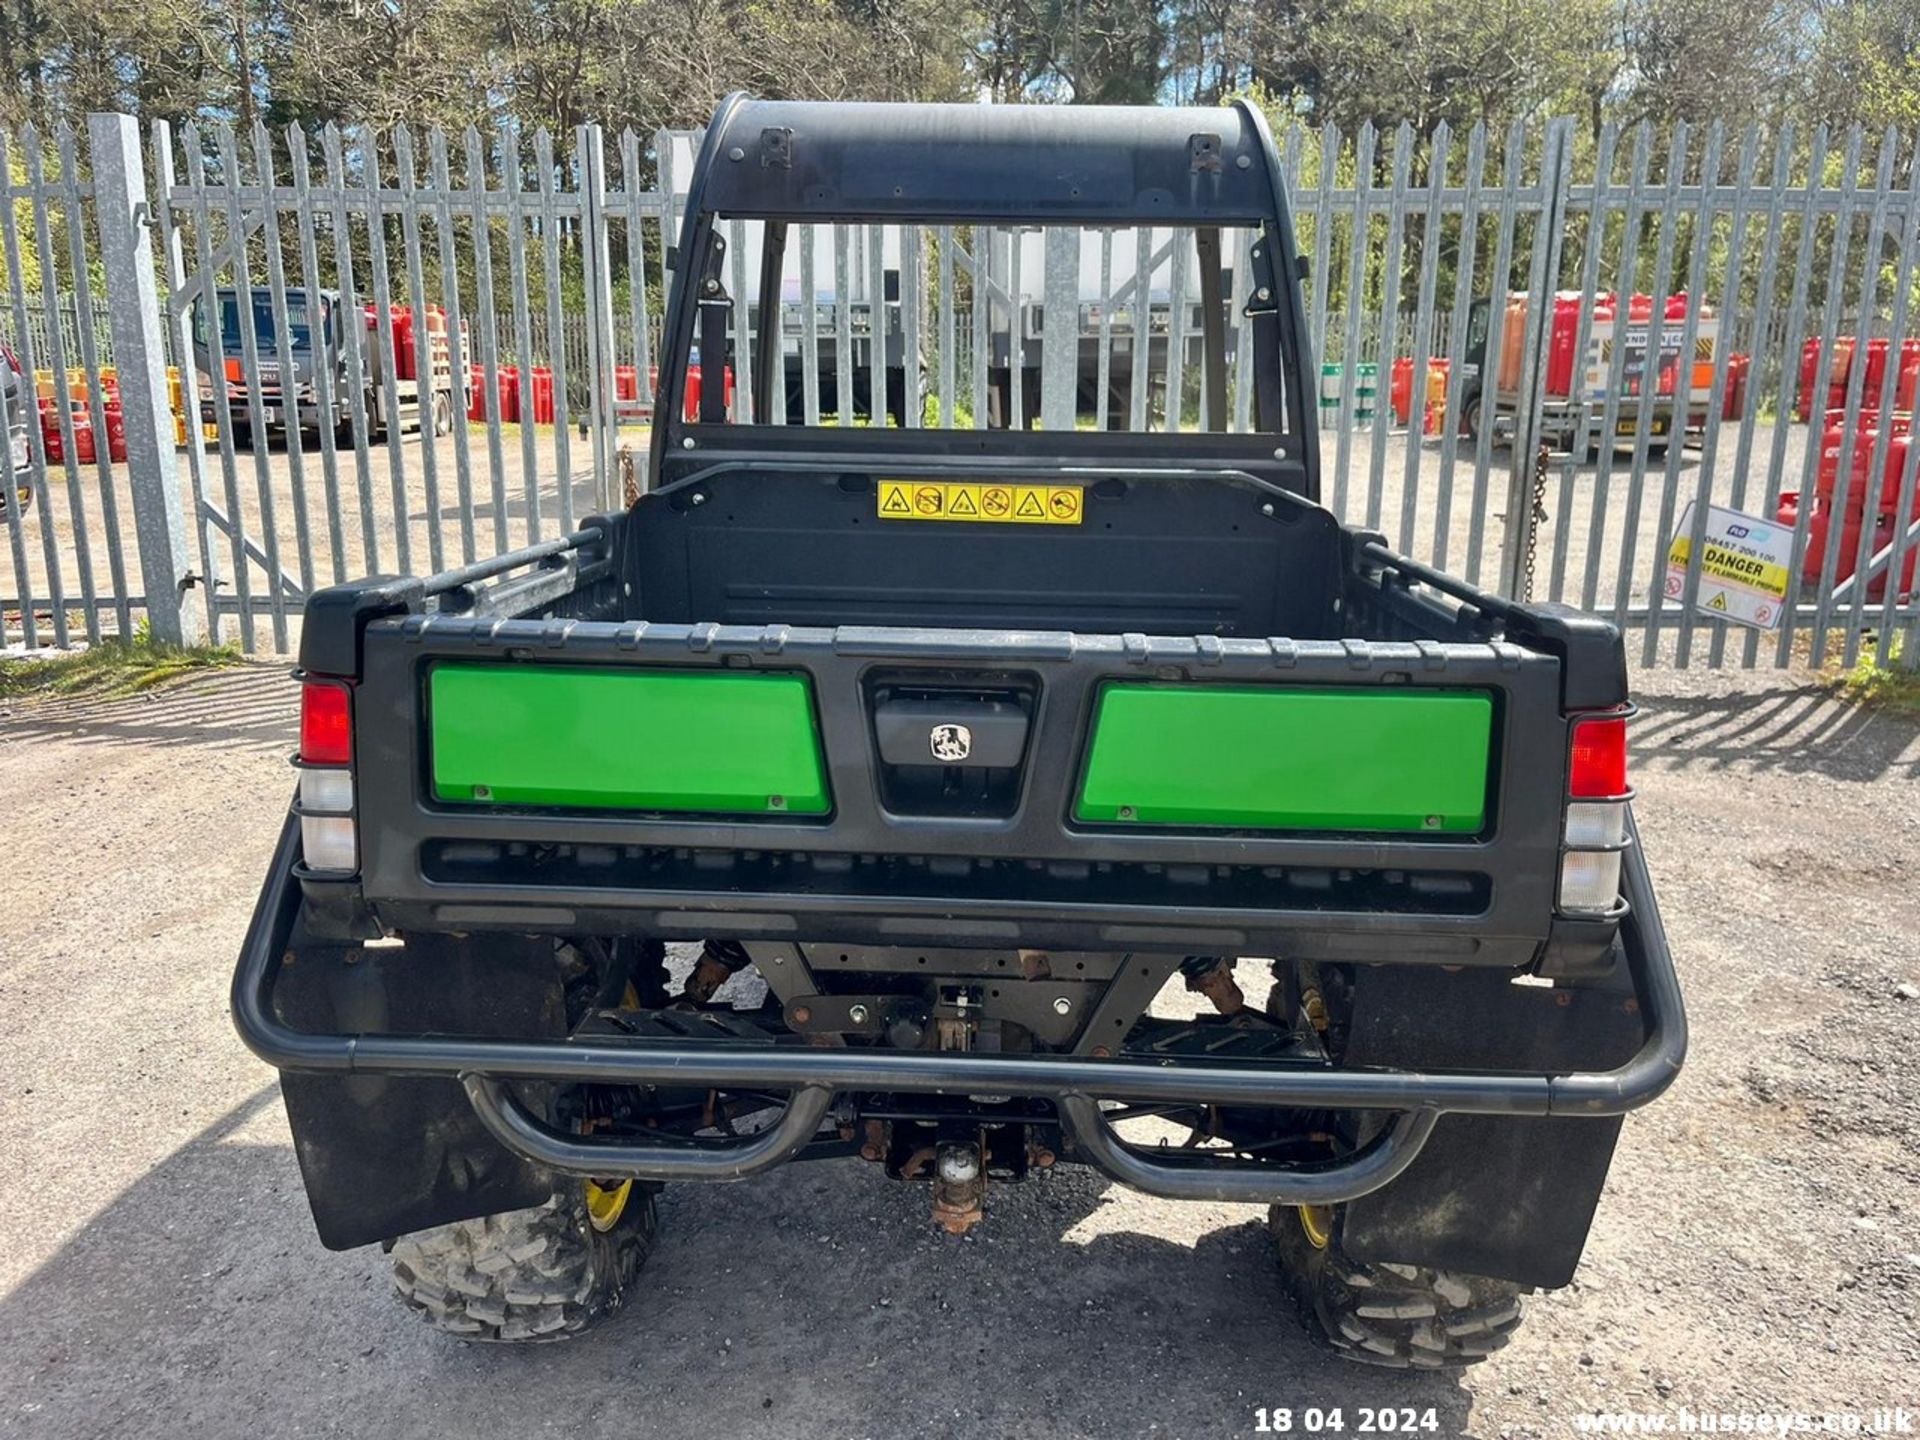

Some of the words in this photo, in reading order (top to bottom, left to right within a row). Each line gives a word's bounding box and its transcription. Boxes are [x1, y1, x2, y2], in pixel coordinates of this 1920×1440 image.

[1705, 549, 1764, 577] DANGER
[1739, 546, 1757, 557] 200
[1760, 551, 1776, 562] 100
[1712, 566, 1755, 586] FLAMMABLE
